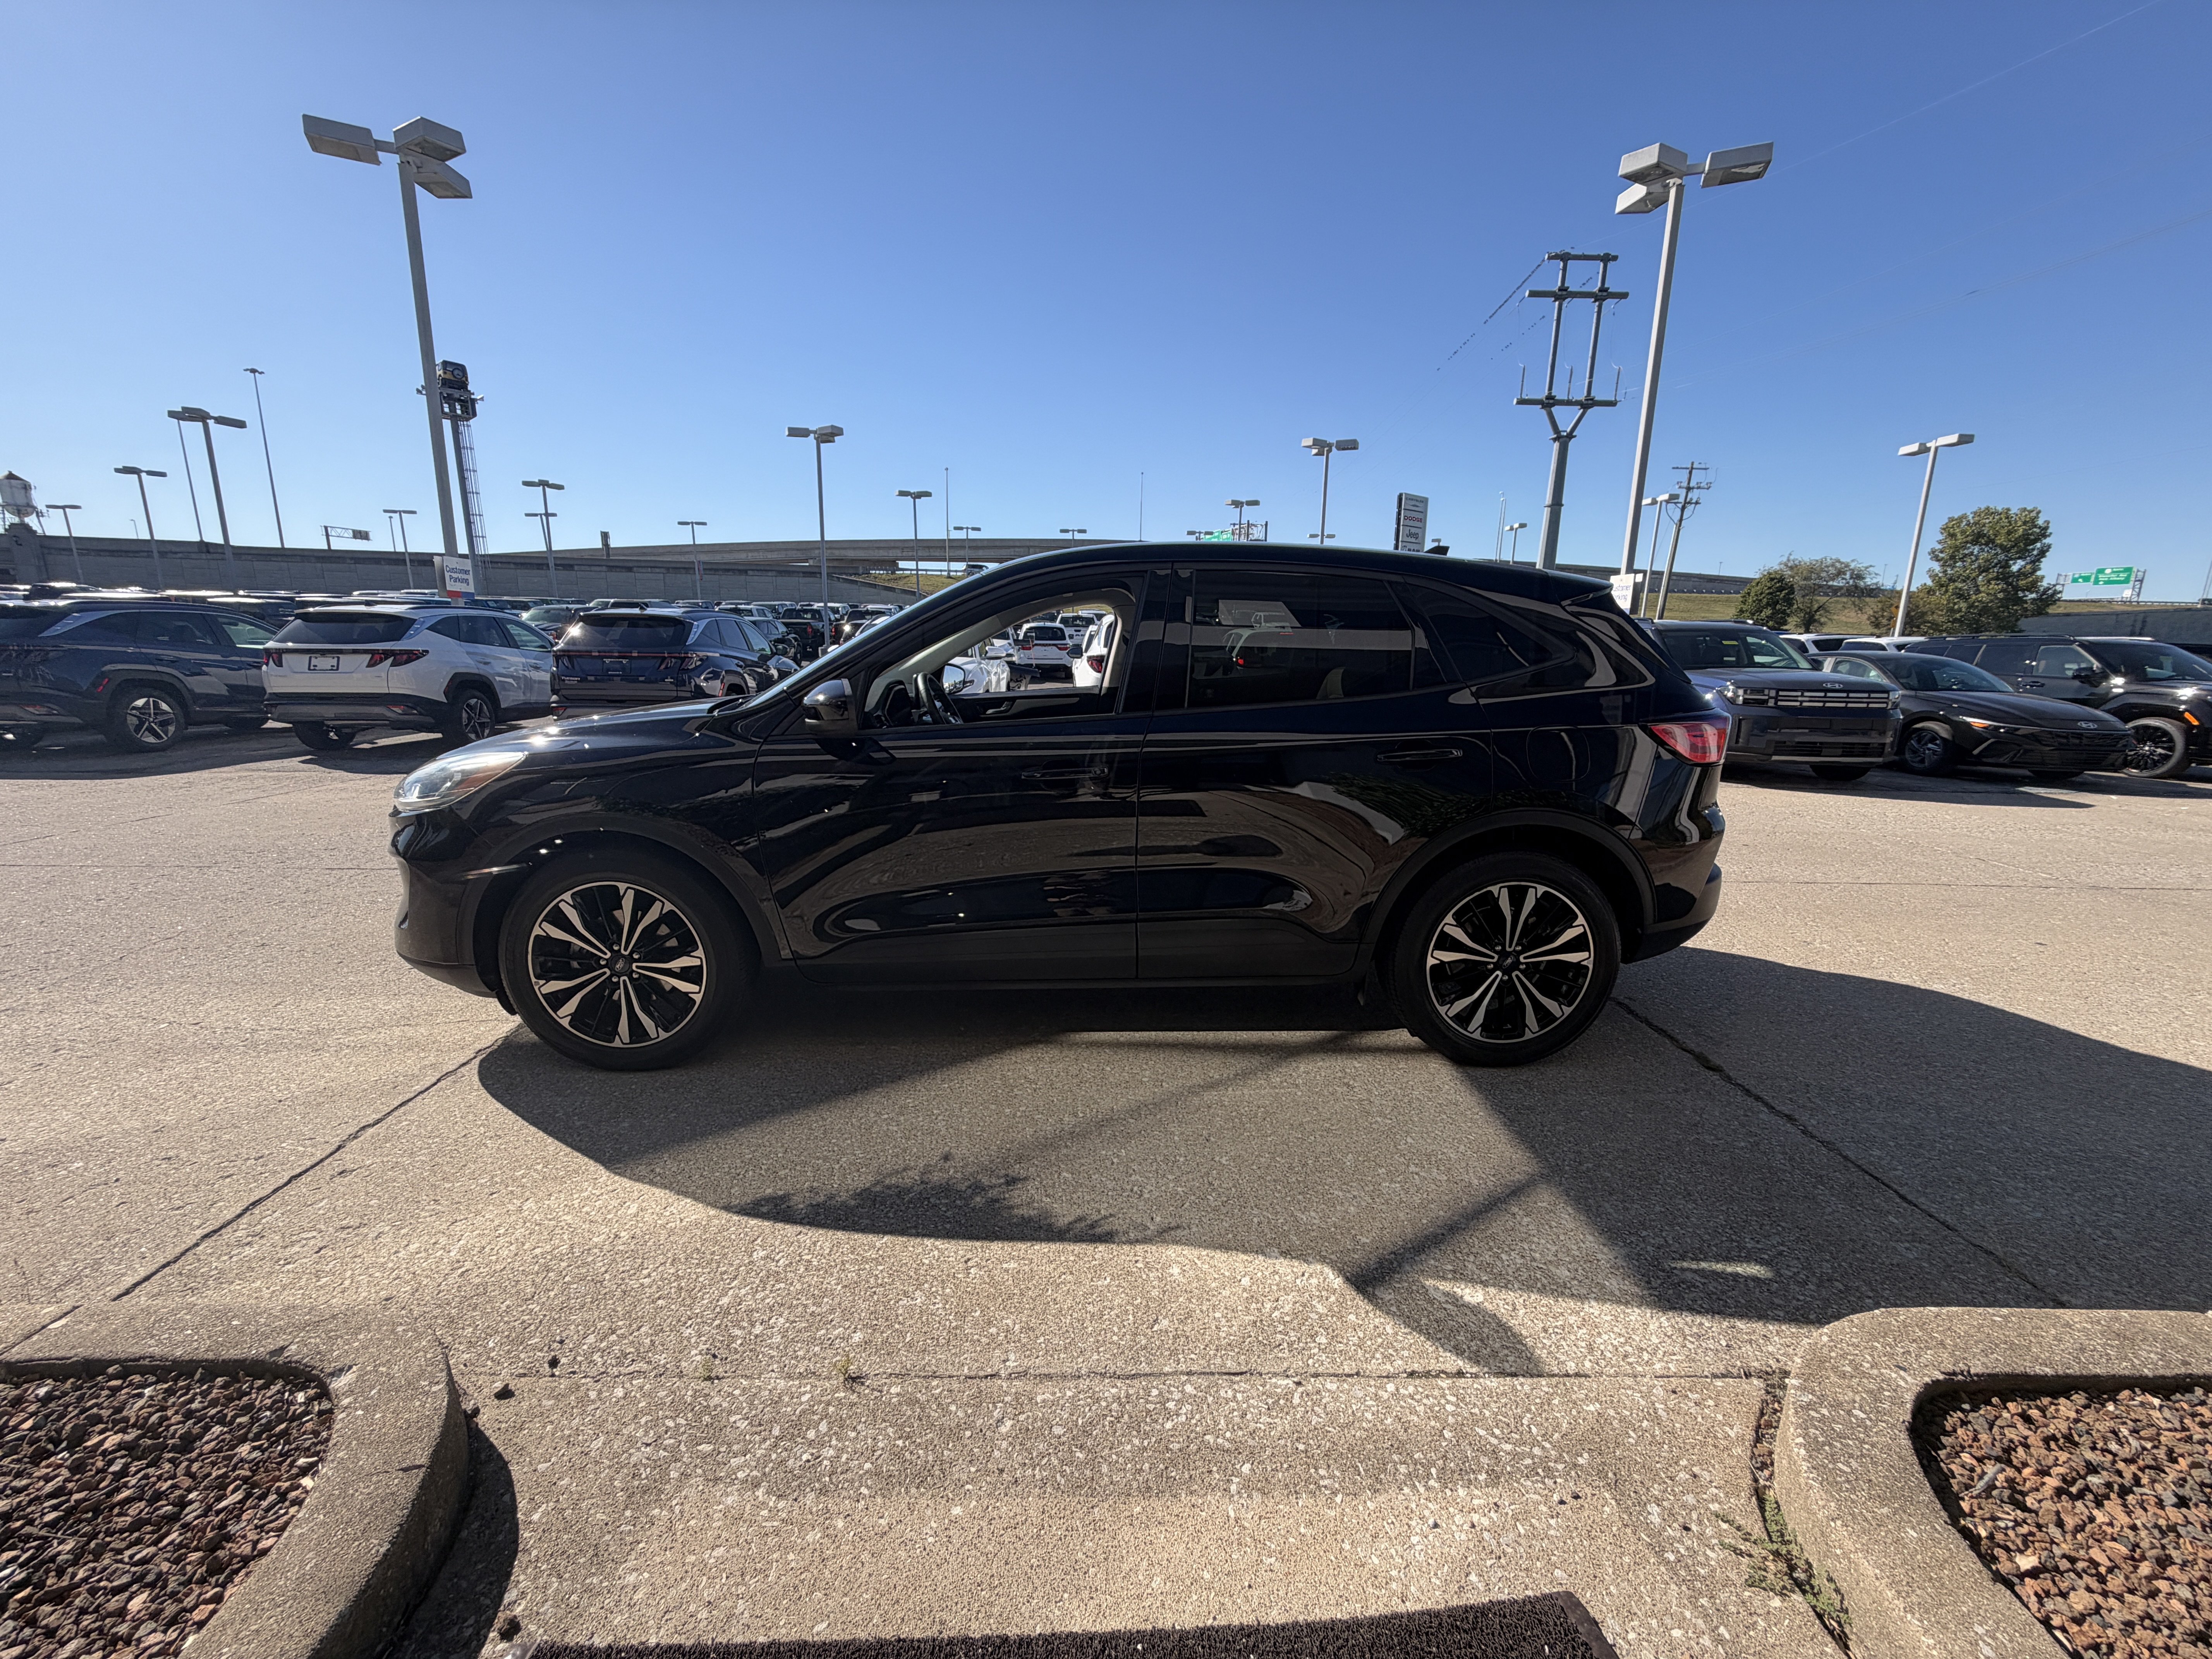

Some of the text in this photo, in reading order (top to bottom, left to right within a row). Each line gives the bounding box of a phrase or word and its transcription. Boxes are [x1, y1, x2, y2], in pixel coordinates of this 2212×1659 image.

[1406, 529, 1419, 541] Jeep
[445, 565, 471, 575] Customer
[449, 575, 469, 586] Parking
